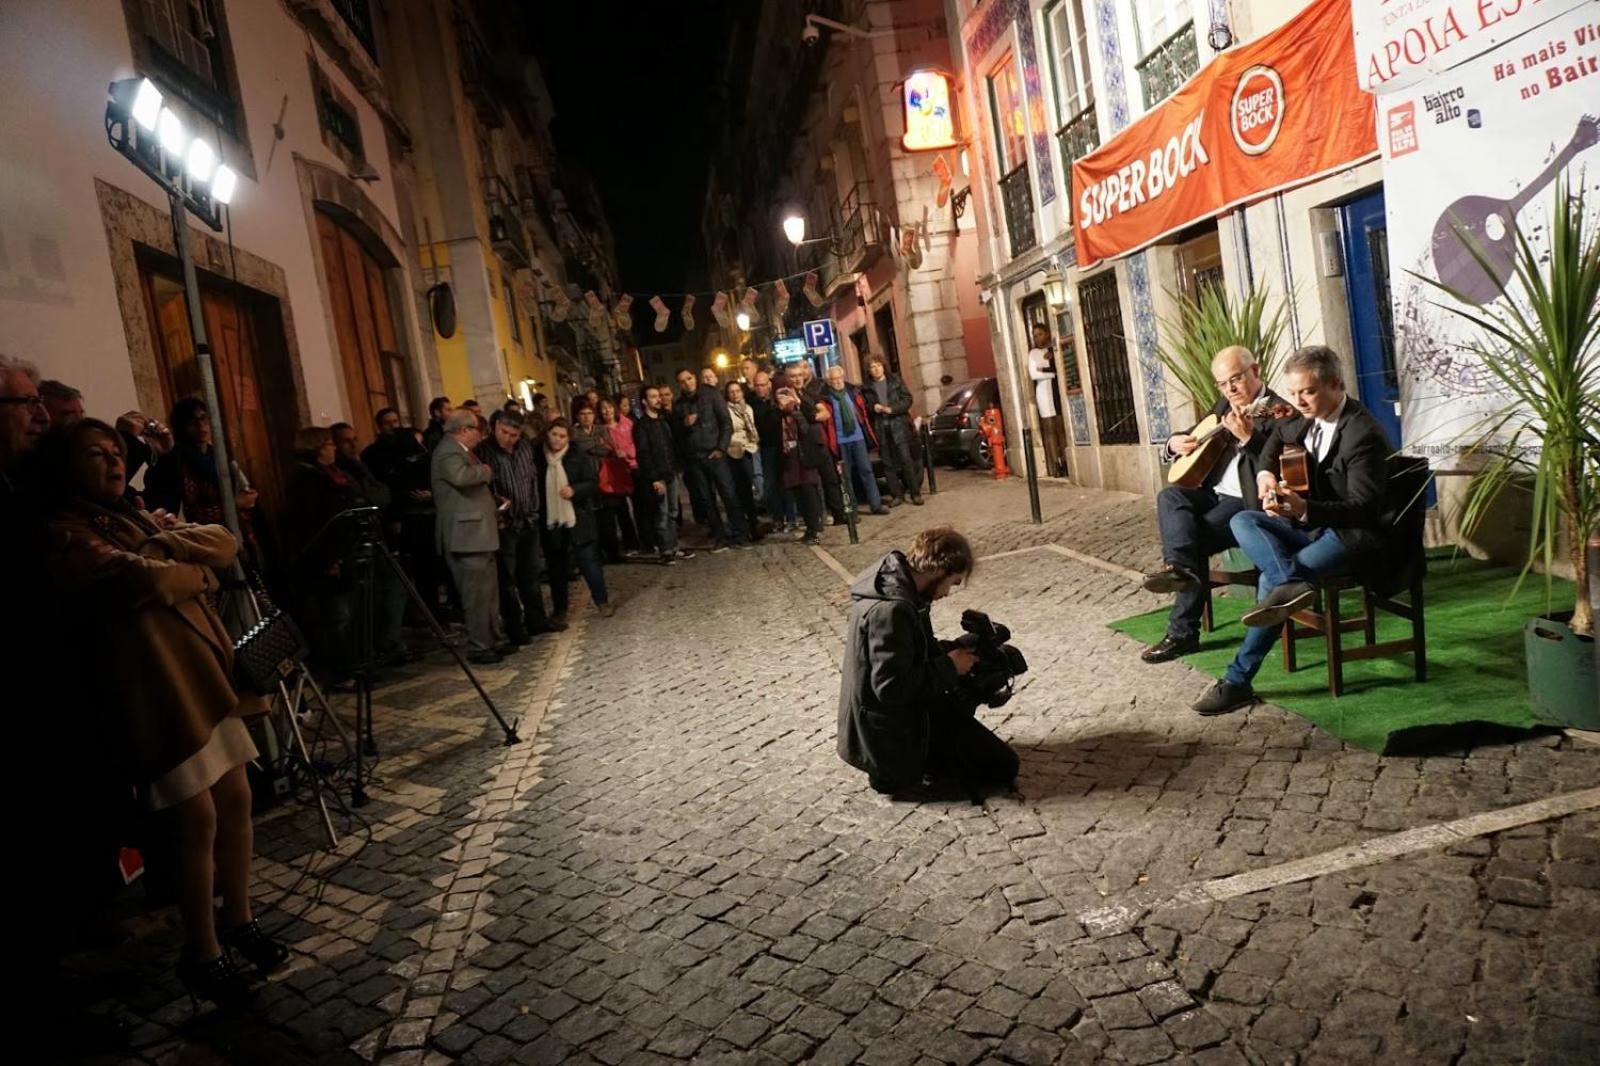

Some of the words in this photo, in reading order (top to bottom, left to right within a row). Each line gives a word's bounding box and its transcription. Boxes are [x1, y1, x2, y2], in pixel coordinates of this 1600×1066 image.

[1368, 6, 1468, 89] APOIA
[1494, 60, 1516, 81] Há
[1522, 41, 1567, 70] mais
[1574, 24, 1600, 46] Vi
[1520, 83, 1540, 99] no
[1545, 56, 1599, 89] Bair
[1237, 87, 1274, 116] SUPER
[1423, 86, 1465, 112] bairro
[1240, 105, 1275, 132] BOCK
[1435, 104, 1461, 124] alto
[1080, 158, 1147, 230] SUPER
[1147, 108, 1210, 200] BOCK
[811, 323, 825, 346] P
